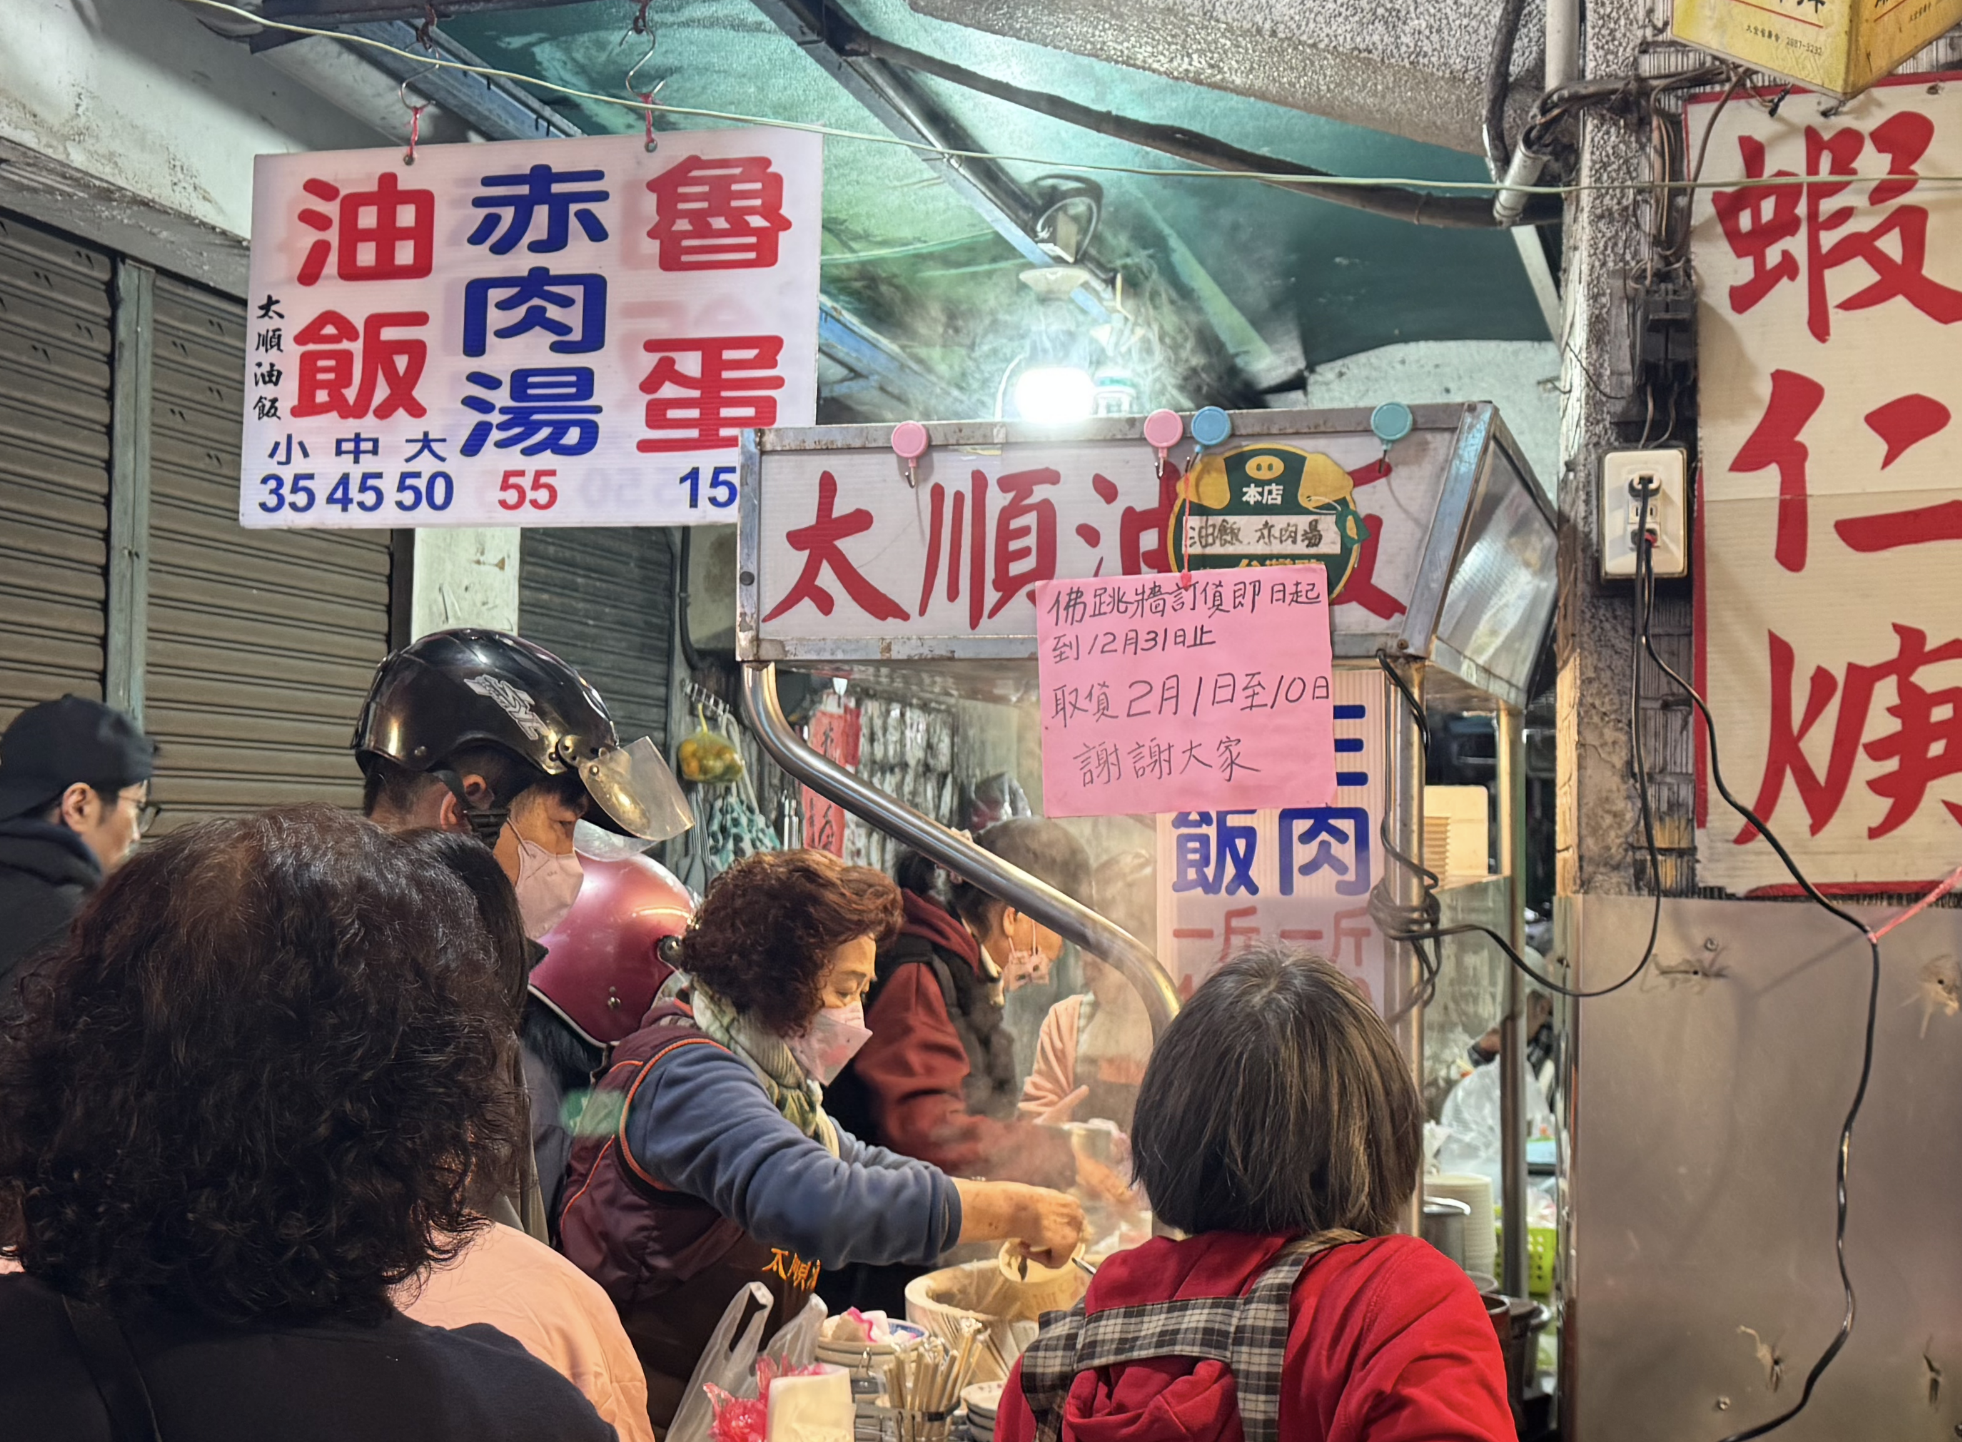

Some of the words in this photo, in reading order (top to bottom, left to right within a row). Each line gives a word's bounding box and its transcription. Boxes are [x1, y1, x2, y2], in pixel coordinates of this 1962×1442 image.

[290, 172, 436, 421] 油飯
[460, 163, 610, 458] 赤肉湯
[635, 154, 792, 454] 魯蛋
[253, 294, 285, 421] 太順油飯
[267, 433, 310, 466] 小
[335, 432, 380, 465] 中
[404, 431, 449, 464] 大
[258, 472, 317, 513] 35
[325, 471, 384, 513] 45
[395, 470, 455, 512] 50
[497, 469, 558, 511] 55
[678, 466, 738, 509] 15
[1241, 483, 1284, 505] 本店
[1051, 623, 1217, 664] 到12月31日止
[1072, 735, 1262, 787] 謝謝大家
